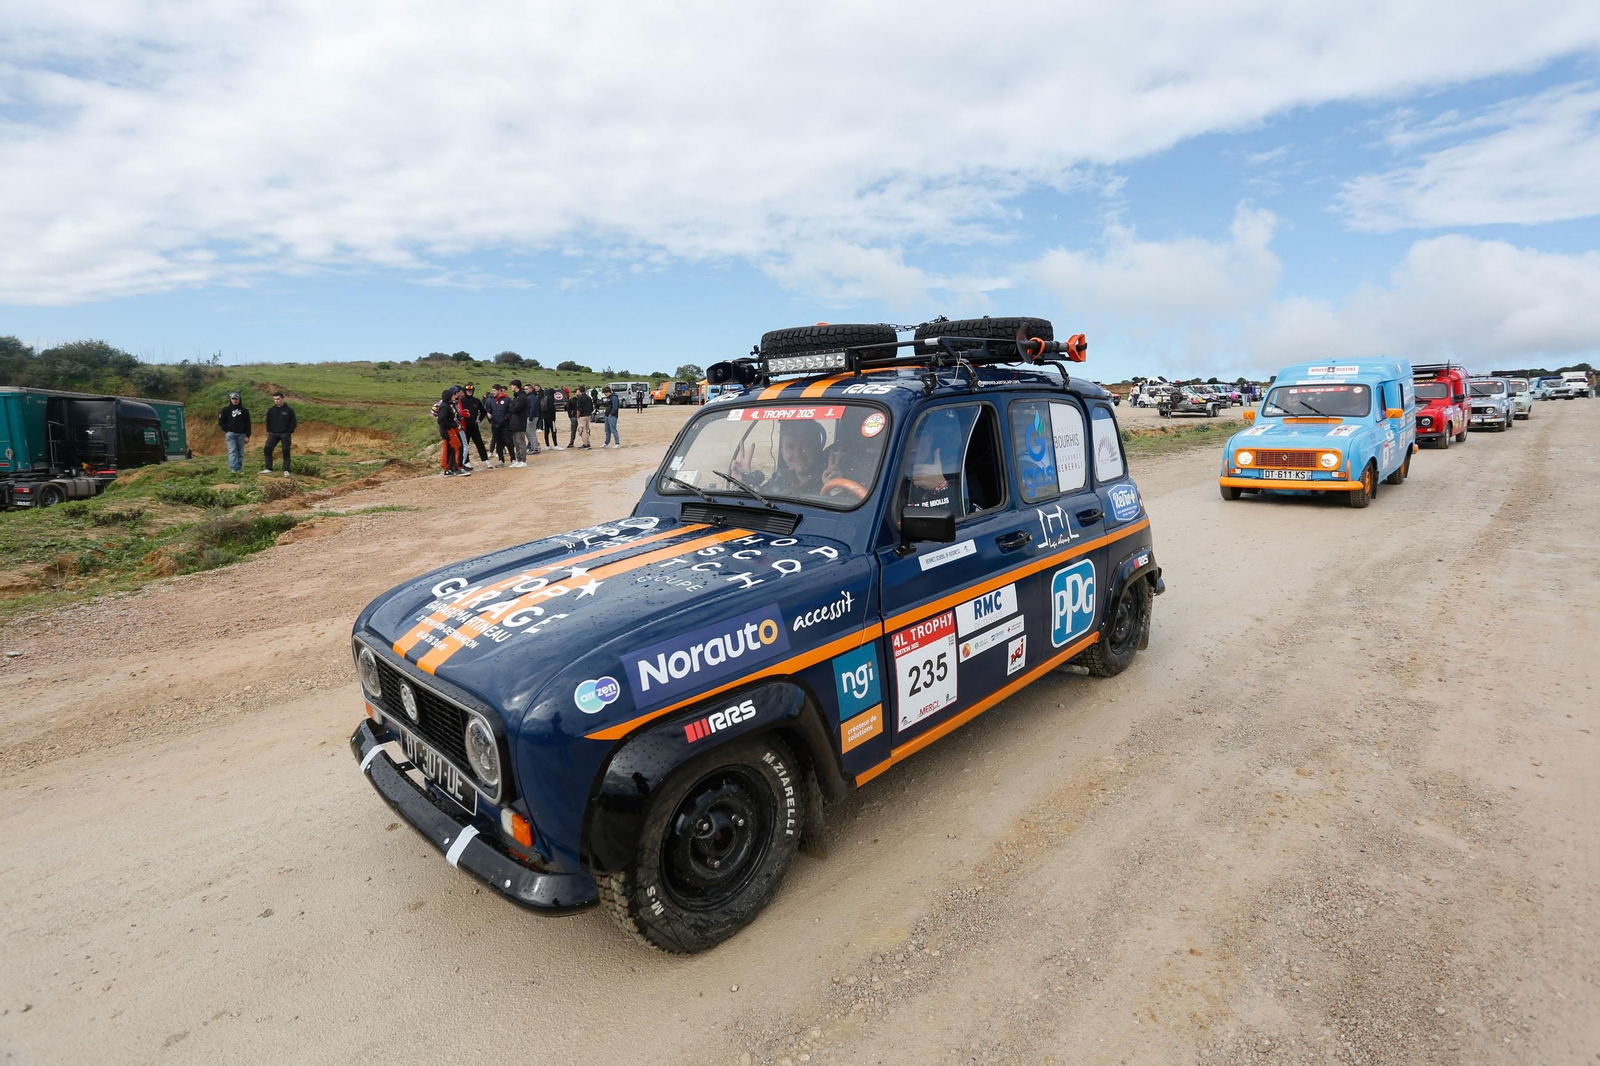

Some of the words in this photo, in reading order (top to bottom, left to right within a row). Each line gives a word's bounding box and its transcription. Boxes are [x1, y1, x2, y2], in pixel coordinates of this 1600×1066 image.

[750, 410, 760, 419] 4L
[762, 409, 796, 419] TROPHY
[796, 408, 816, 418] 2025
[1053, 433, 1080, 449] BOURHIS
[1023, 465, 1057, 498] gas
[1057, 461, 1083, 473] GENERALI
[929, 497, 950, 507] MIOLLIS
[500, 574, 571, 600] TOP
[431, 576, 569, 635] GARAGE
[792, 590, 855, 632] accessit
[973, 590, 1003, 621] RMC
[451, 608, 512, 643] MARTINEAU
[893, 633, 908, 648] 4L
[910, 612, 953, 641] TROPHY
[637, 618, 779, 692] Norauto
[841, 661, 874, 700] ngi
[908, 652, 948, 698] 235
[707, 698, 757, 734] RRS
[847, 718, 870, 735] créateur
[869, 714, 877, 723] de
[847, 724, 874, 743] solutions
